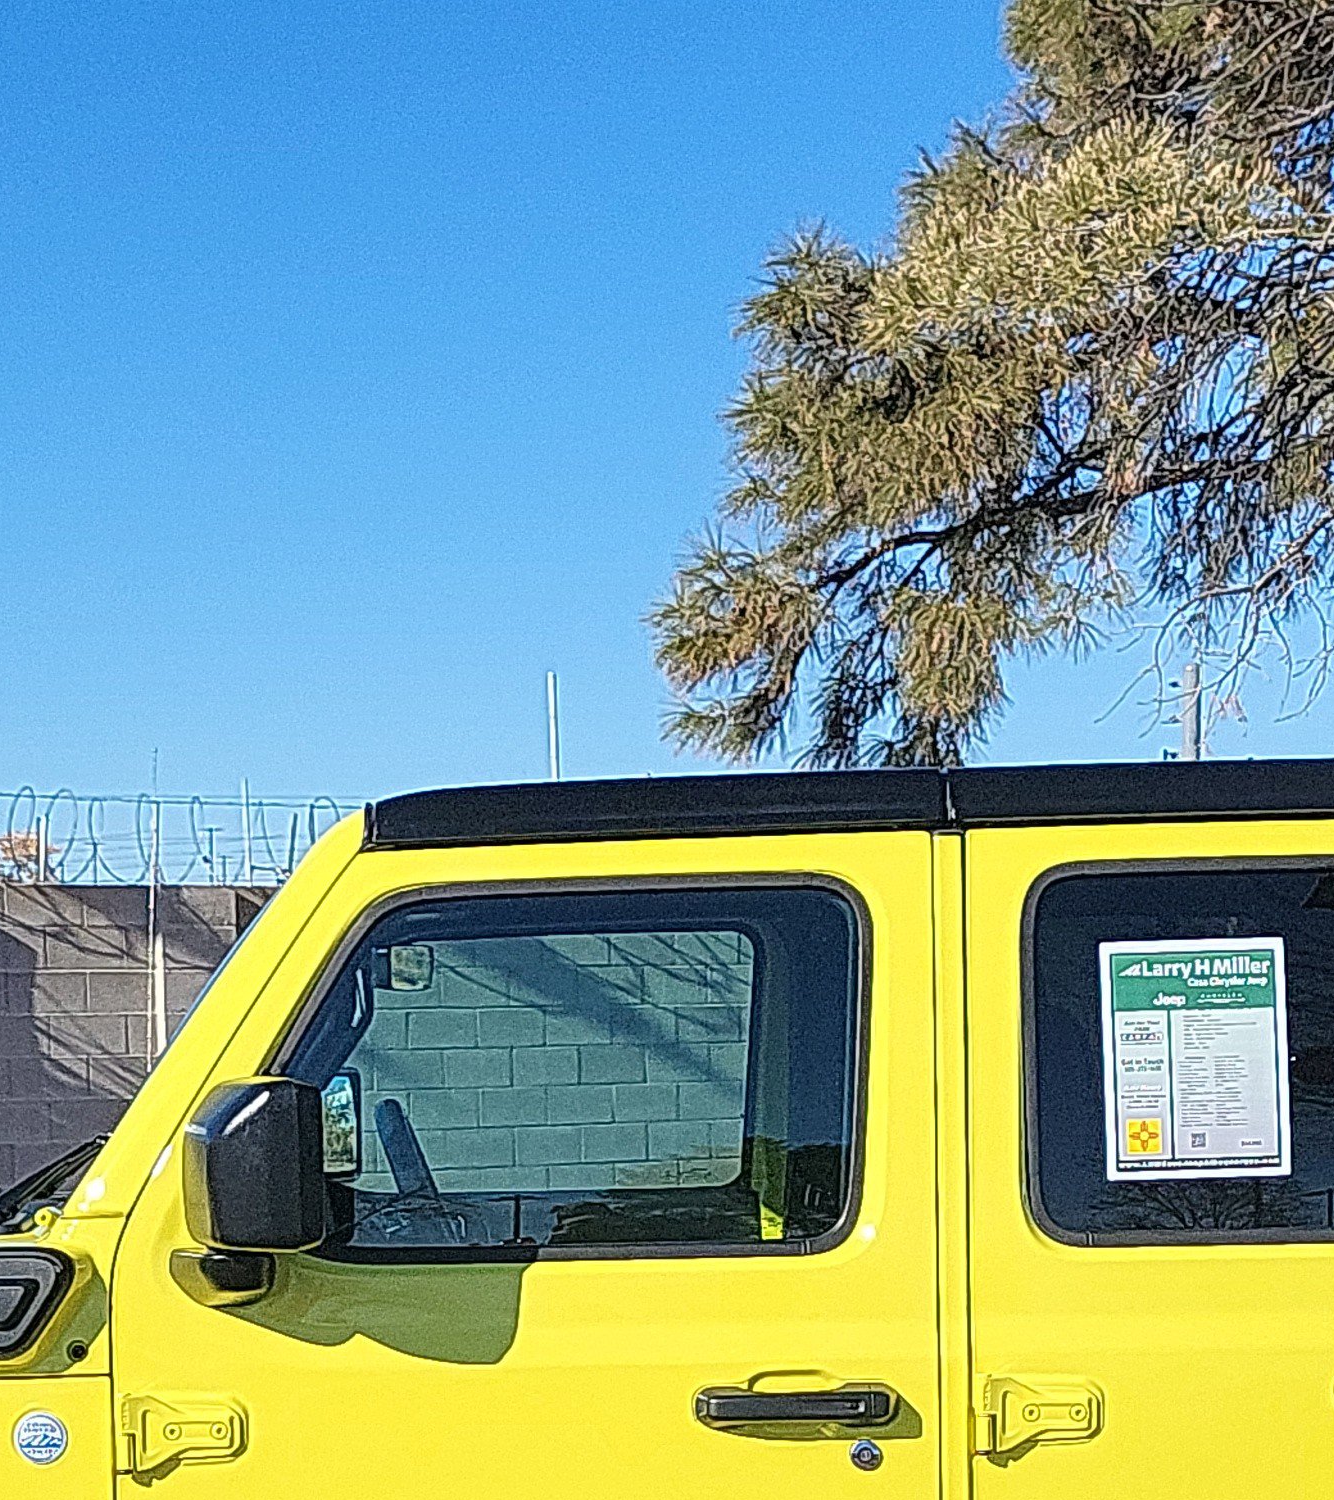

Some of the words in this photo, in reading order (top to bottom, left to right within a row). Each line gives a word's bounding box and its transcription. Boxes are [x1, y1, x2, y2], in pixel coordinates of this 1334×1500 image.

[1141, 960, 1193, 979] Larry
[1194, 959, 1210, 975] H
[1212, 956, 1271, 975] Miller
[1152, 992, 1186, 1007] Jeep
